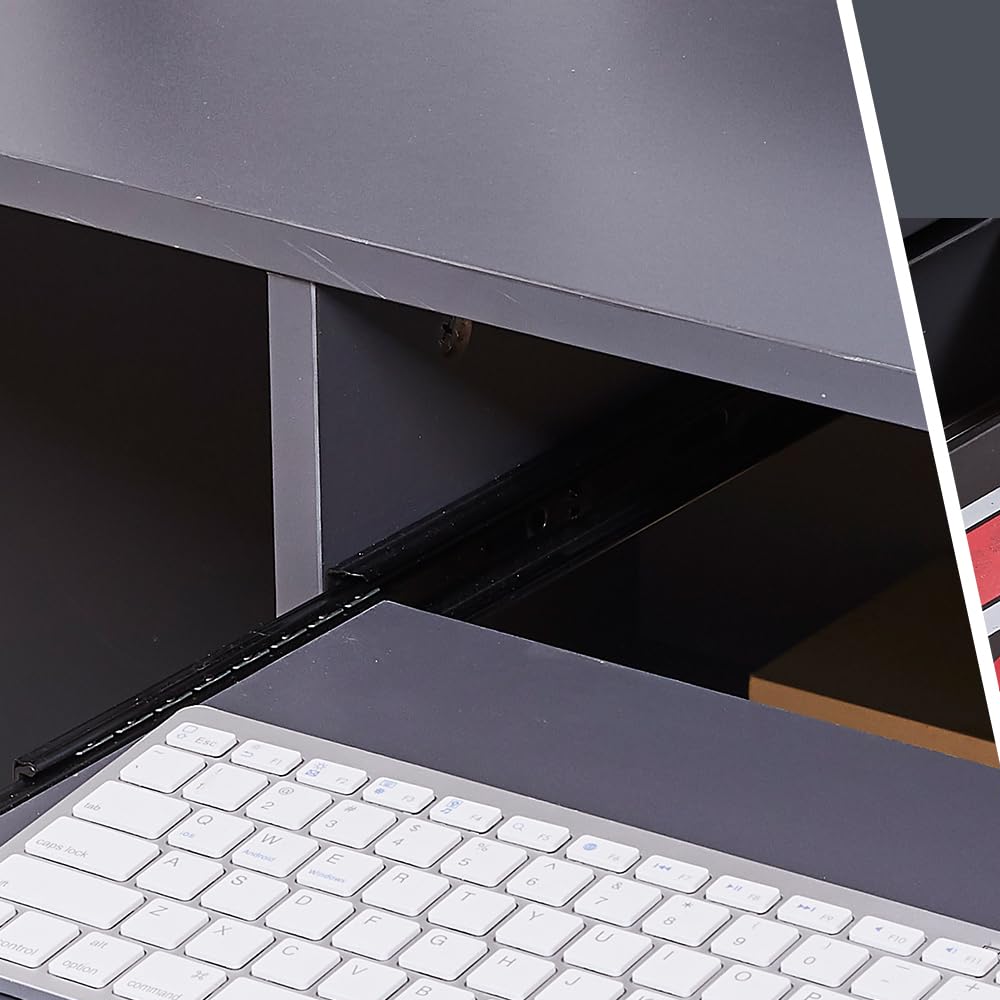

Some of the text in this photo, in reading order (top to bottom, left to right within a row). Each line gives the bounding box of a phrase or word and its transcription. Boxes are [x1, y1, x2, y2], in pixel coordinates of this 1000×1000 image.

[84, 802, 101, 812] tab
[260, 802, 275, 810] 2
[197, 815, 214, 826] Q
[325, 820, 338, 828] 3
[261, 833, 283, 845] W
[392, 838, 405, 846] 4
[35, 837, 89, 859] caps lock
[163, 857, 180, 867] A
[326, 854, 344, 864] E
[457, 857, 472, 866] 5
[231, 875, 248, 885] S
[392, 872, 409, 883] R
[526, 877, 539, 886] 6
[295, 895, 312, 905] D
[461, 891, 476, 901] T
[594, 896, 609, 905] 7
[149, 905, 168, 916] Z
[363, 915, 382, 925] F
[529, 911, 544, 921] Y
[663, 917, 677, 925] 8
[213, 925, 233, 936] X
[430, 935, 448, 946] G
[595, 931, 614, 942] U
[733, 937, 746, 945] 9
[90, 938, 108, 949] alt
[282, 946, 299, 955] C
[497, 956, 517, 967] H
[62, 959, 99, 976] option
[352, 965, 368, 975] V
[565, 976, 581, 986] J
[734, 971, 752, 981] O
[127, 980, 183, 1000] command
[416, 985, 432, 997] B
[804, 992, 822, 1000] P
